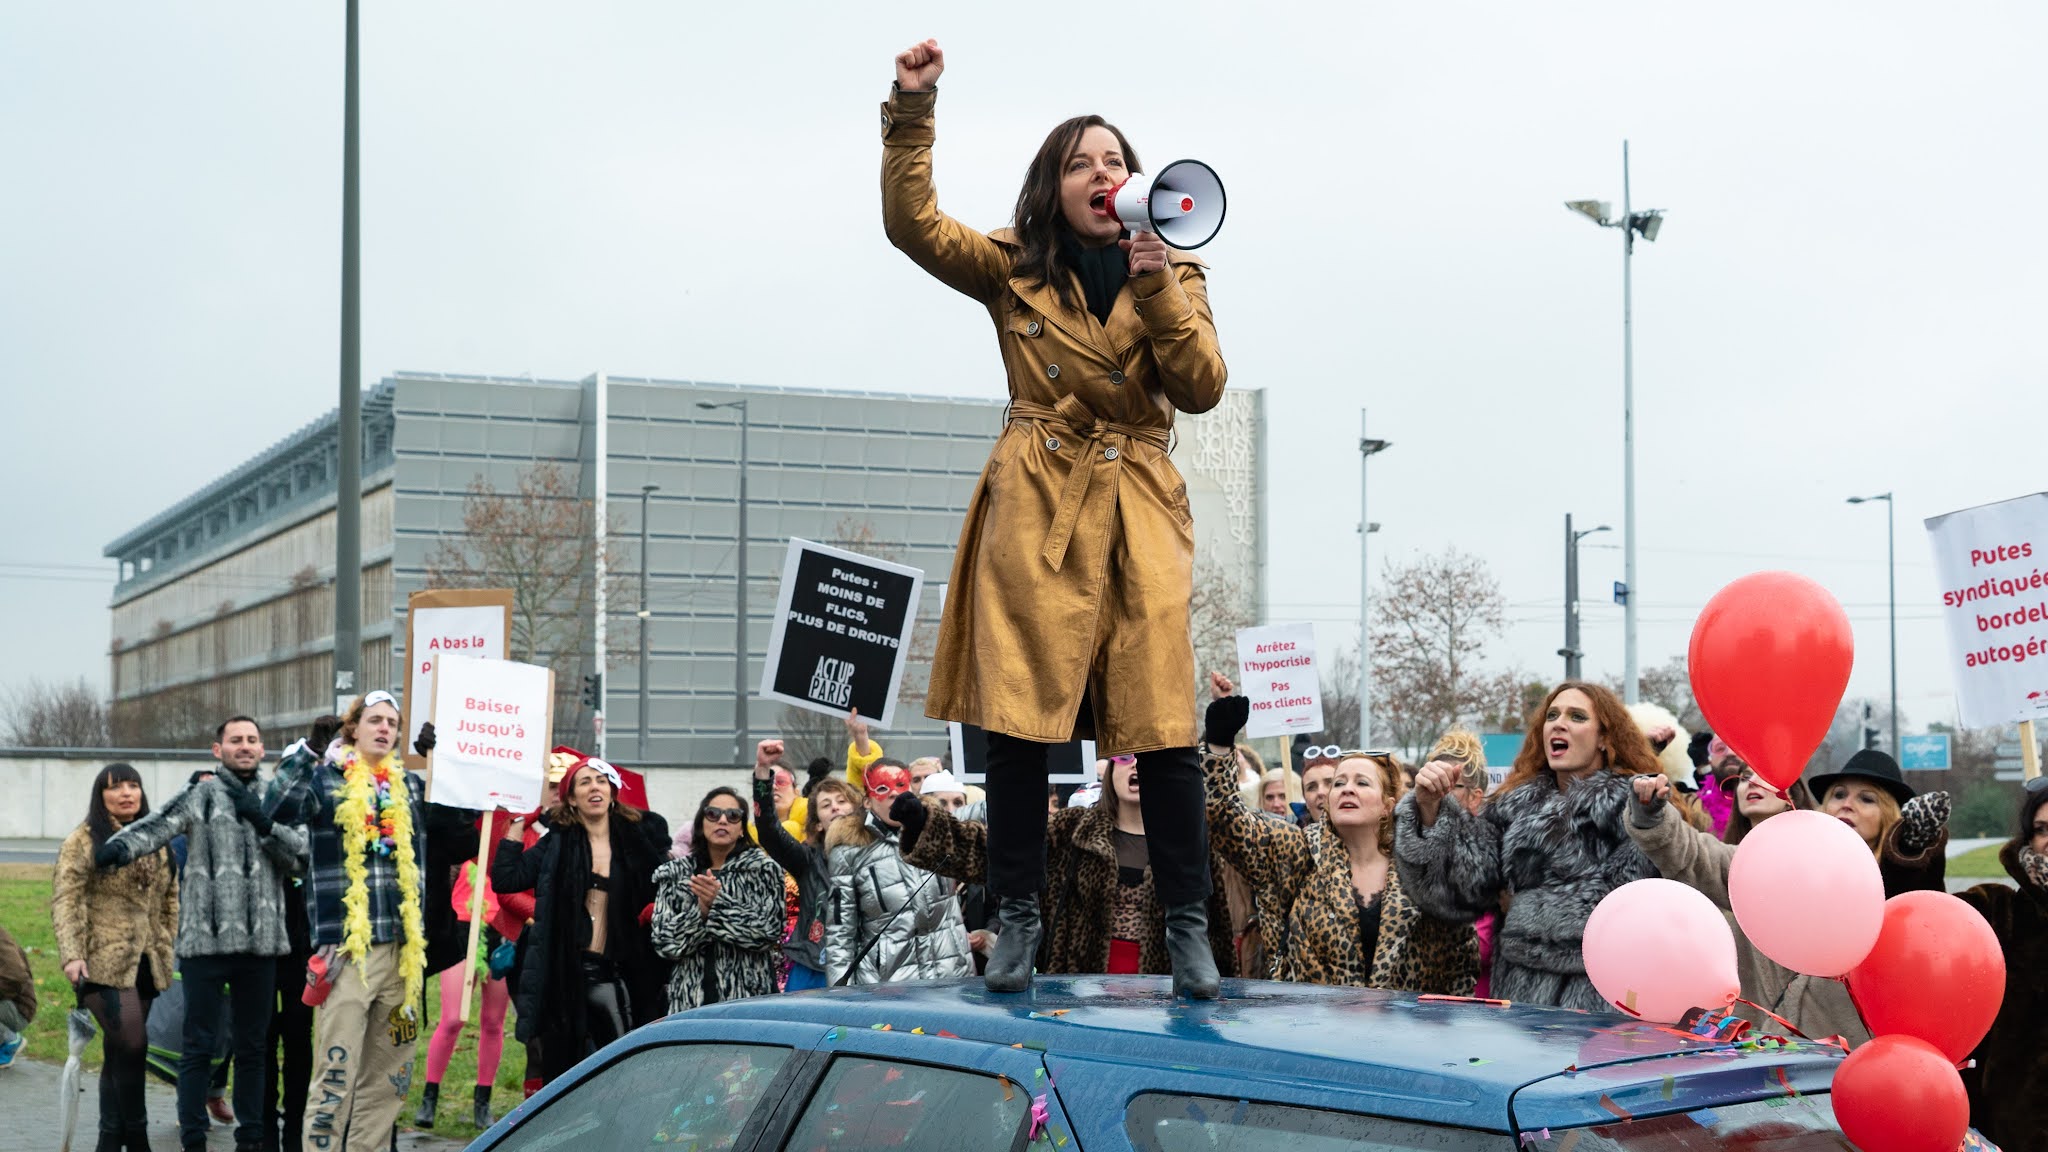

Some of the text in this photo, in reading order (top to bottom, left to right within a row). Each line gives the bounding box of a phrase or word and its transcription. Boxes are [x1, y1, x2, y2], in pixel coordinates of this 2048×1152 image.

[1970, 542, 2033, 567] Putes
[831, 567, 870, 587] Putes
[817, 582, 886, 609] MOINS DE
[825, 602, 869, 625] FLICS,
[1976, 602, 2048, 632] bordel
[788, 610, 900, 649] PLUS DE DROITS
[429, 635, 485, 650] A bas la
[1255, 641, 1297, 654] Arrêtez
[1965, 635, 2048, 668] autogér
[814, 655, 856, 685] ACT UP
[1244, 655, 1311, 673] l'hypocrisie
[809, 676, 851, 707] PARIS
[1271, 682, 1290, 692] Pas
[465, 697, 520, 715] Baiser
[1252, 695, 1312, 711] nos clients
[457, 719, 525, 739] Jusqu'à
[456, 741, 523, 761] Vaincre
